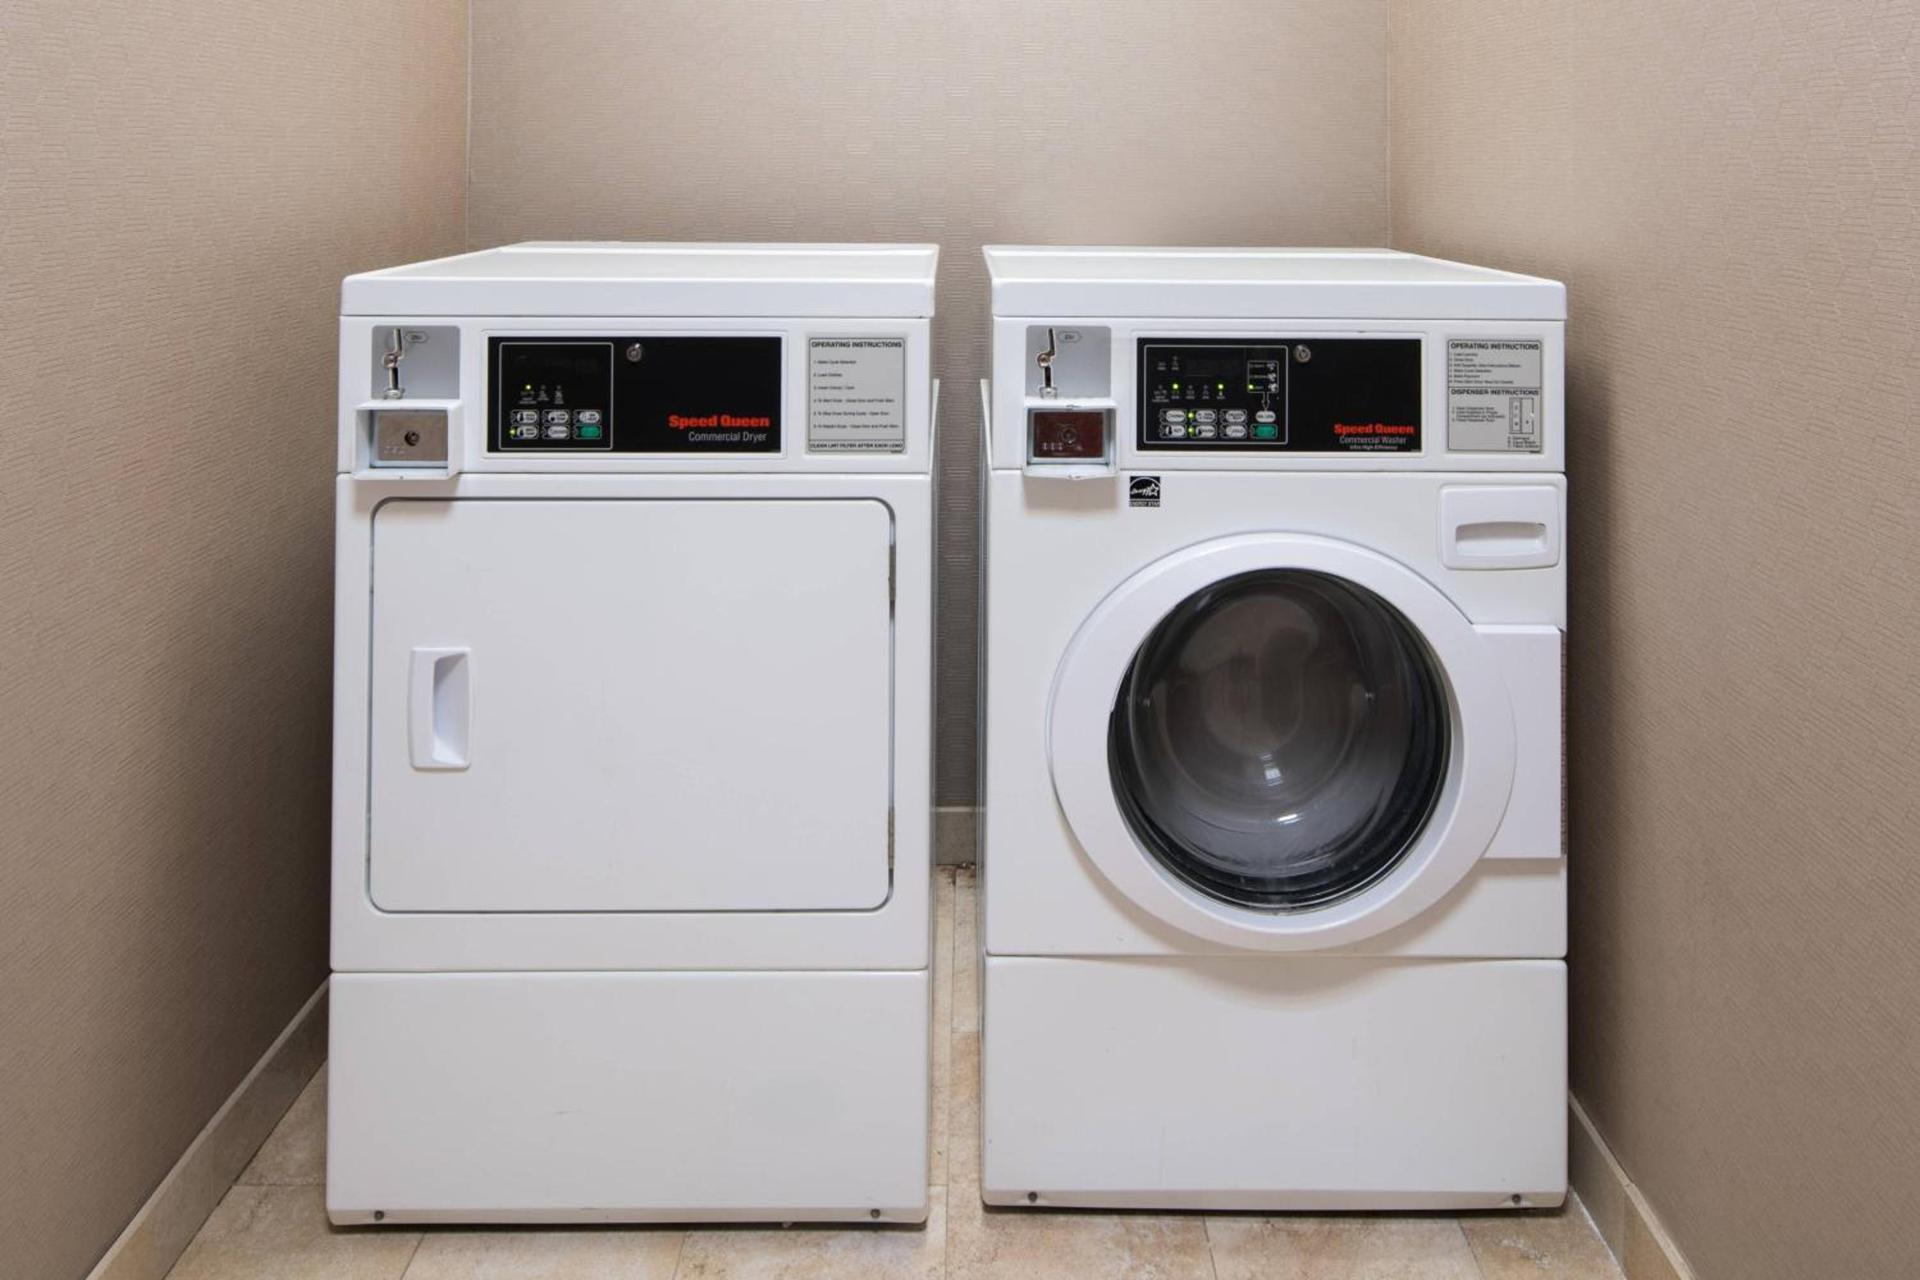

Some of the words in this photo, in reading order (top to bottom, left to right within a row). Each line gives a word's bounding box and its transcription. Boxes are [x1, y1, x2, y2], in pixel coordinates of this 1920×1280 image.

[1491, 343, 1539, 351] INSTRUCTIONS
[668, 415, 718, 430] Speed
[720, 415, 770, 428] Queen
[1334, 423, 1373, 436] Speed
[1375, 423, 1415, 434] Queen
[688, 431, 741, 441] Commercial
[742, 431, 767, 443] Dryer
[1339, 436, 1380, 444] Commercial
[1382, 436, 1407, 444] Washer
